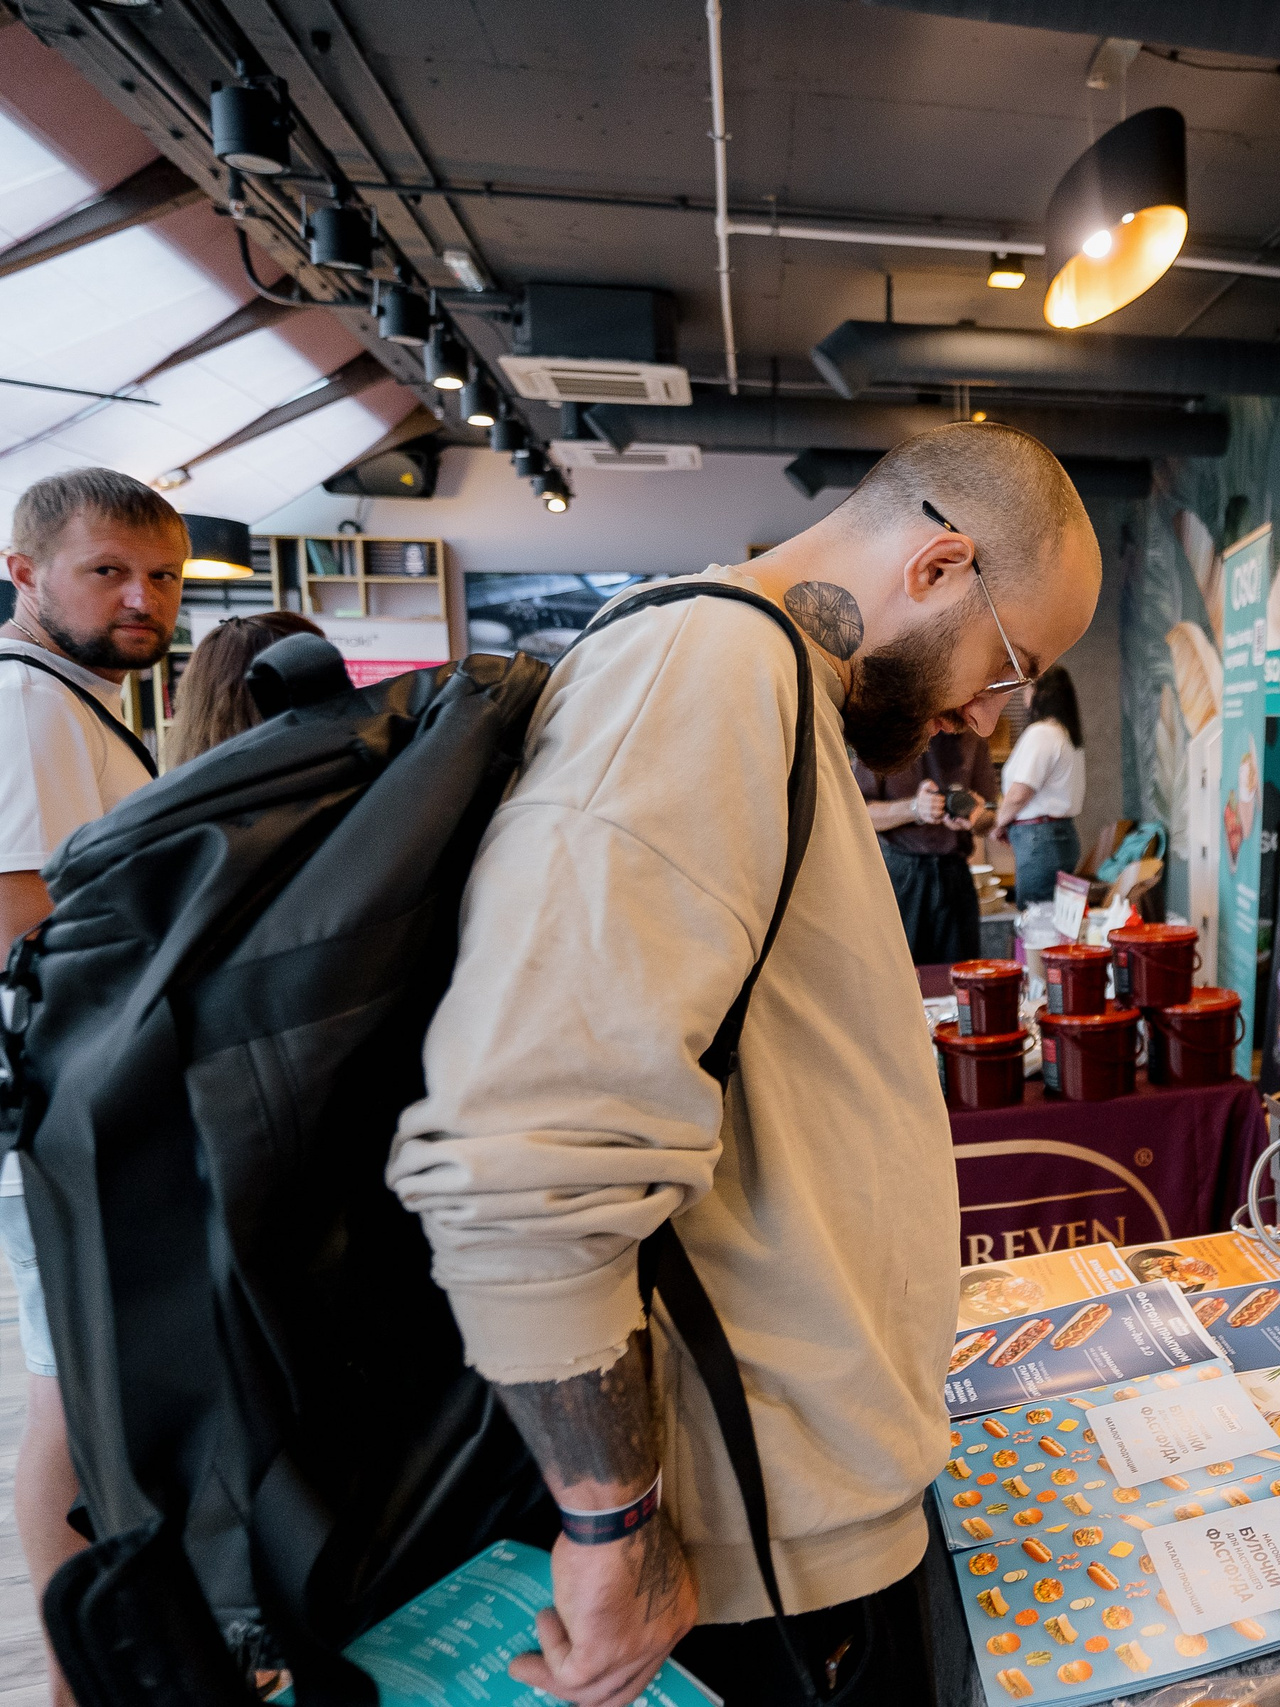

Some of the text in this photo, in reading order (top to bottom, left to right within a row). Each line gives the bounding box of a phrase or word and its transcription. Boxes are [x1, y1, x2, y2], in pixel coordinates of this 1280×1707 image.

[1134, 1292, 1165, 1328] ФАСТФУД
[1156, 1327, 1190, 1363] ПРАКТИКУМ
[1104, 1417, 1138, 1473] КАТАЛОГ ПРОДУКЦИИ
[1139, 1407, 1180, 1464] ФАСТФУДА
[1167, 1404, 1206, 1452] БУЛОЧКИ
[1163, 1540, 1205, 1615] КАТАЛОГ ПРОДУКЦИИ
[1203, 1528, 1255, 1604] ФАСТФУДА
[1224, 1532, 1263, 1590] ДЛЯ НАСТОЯЩЕГО
